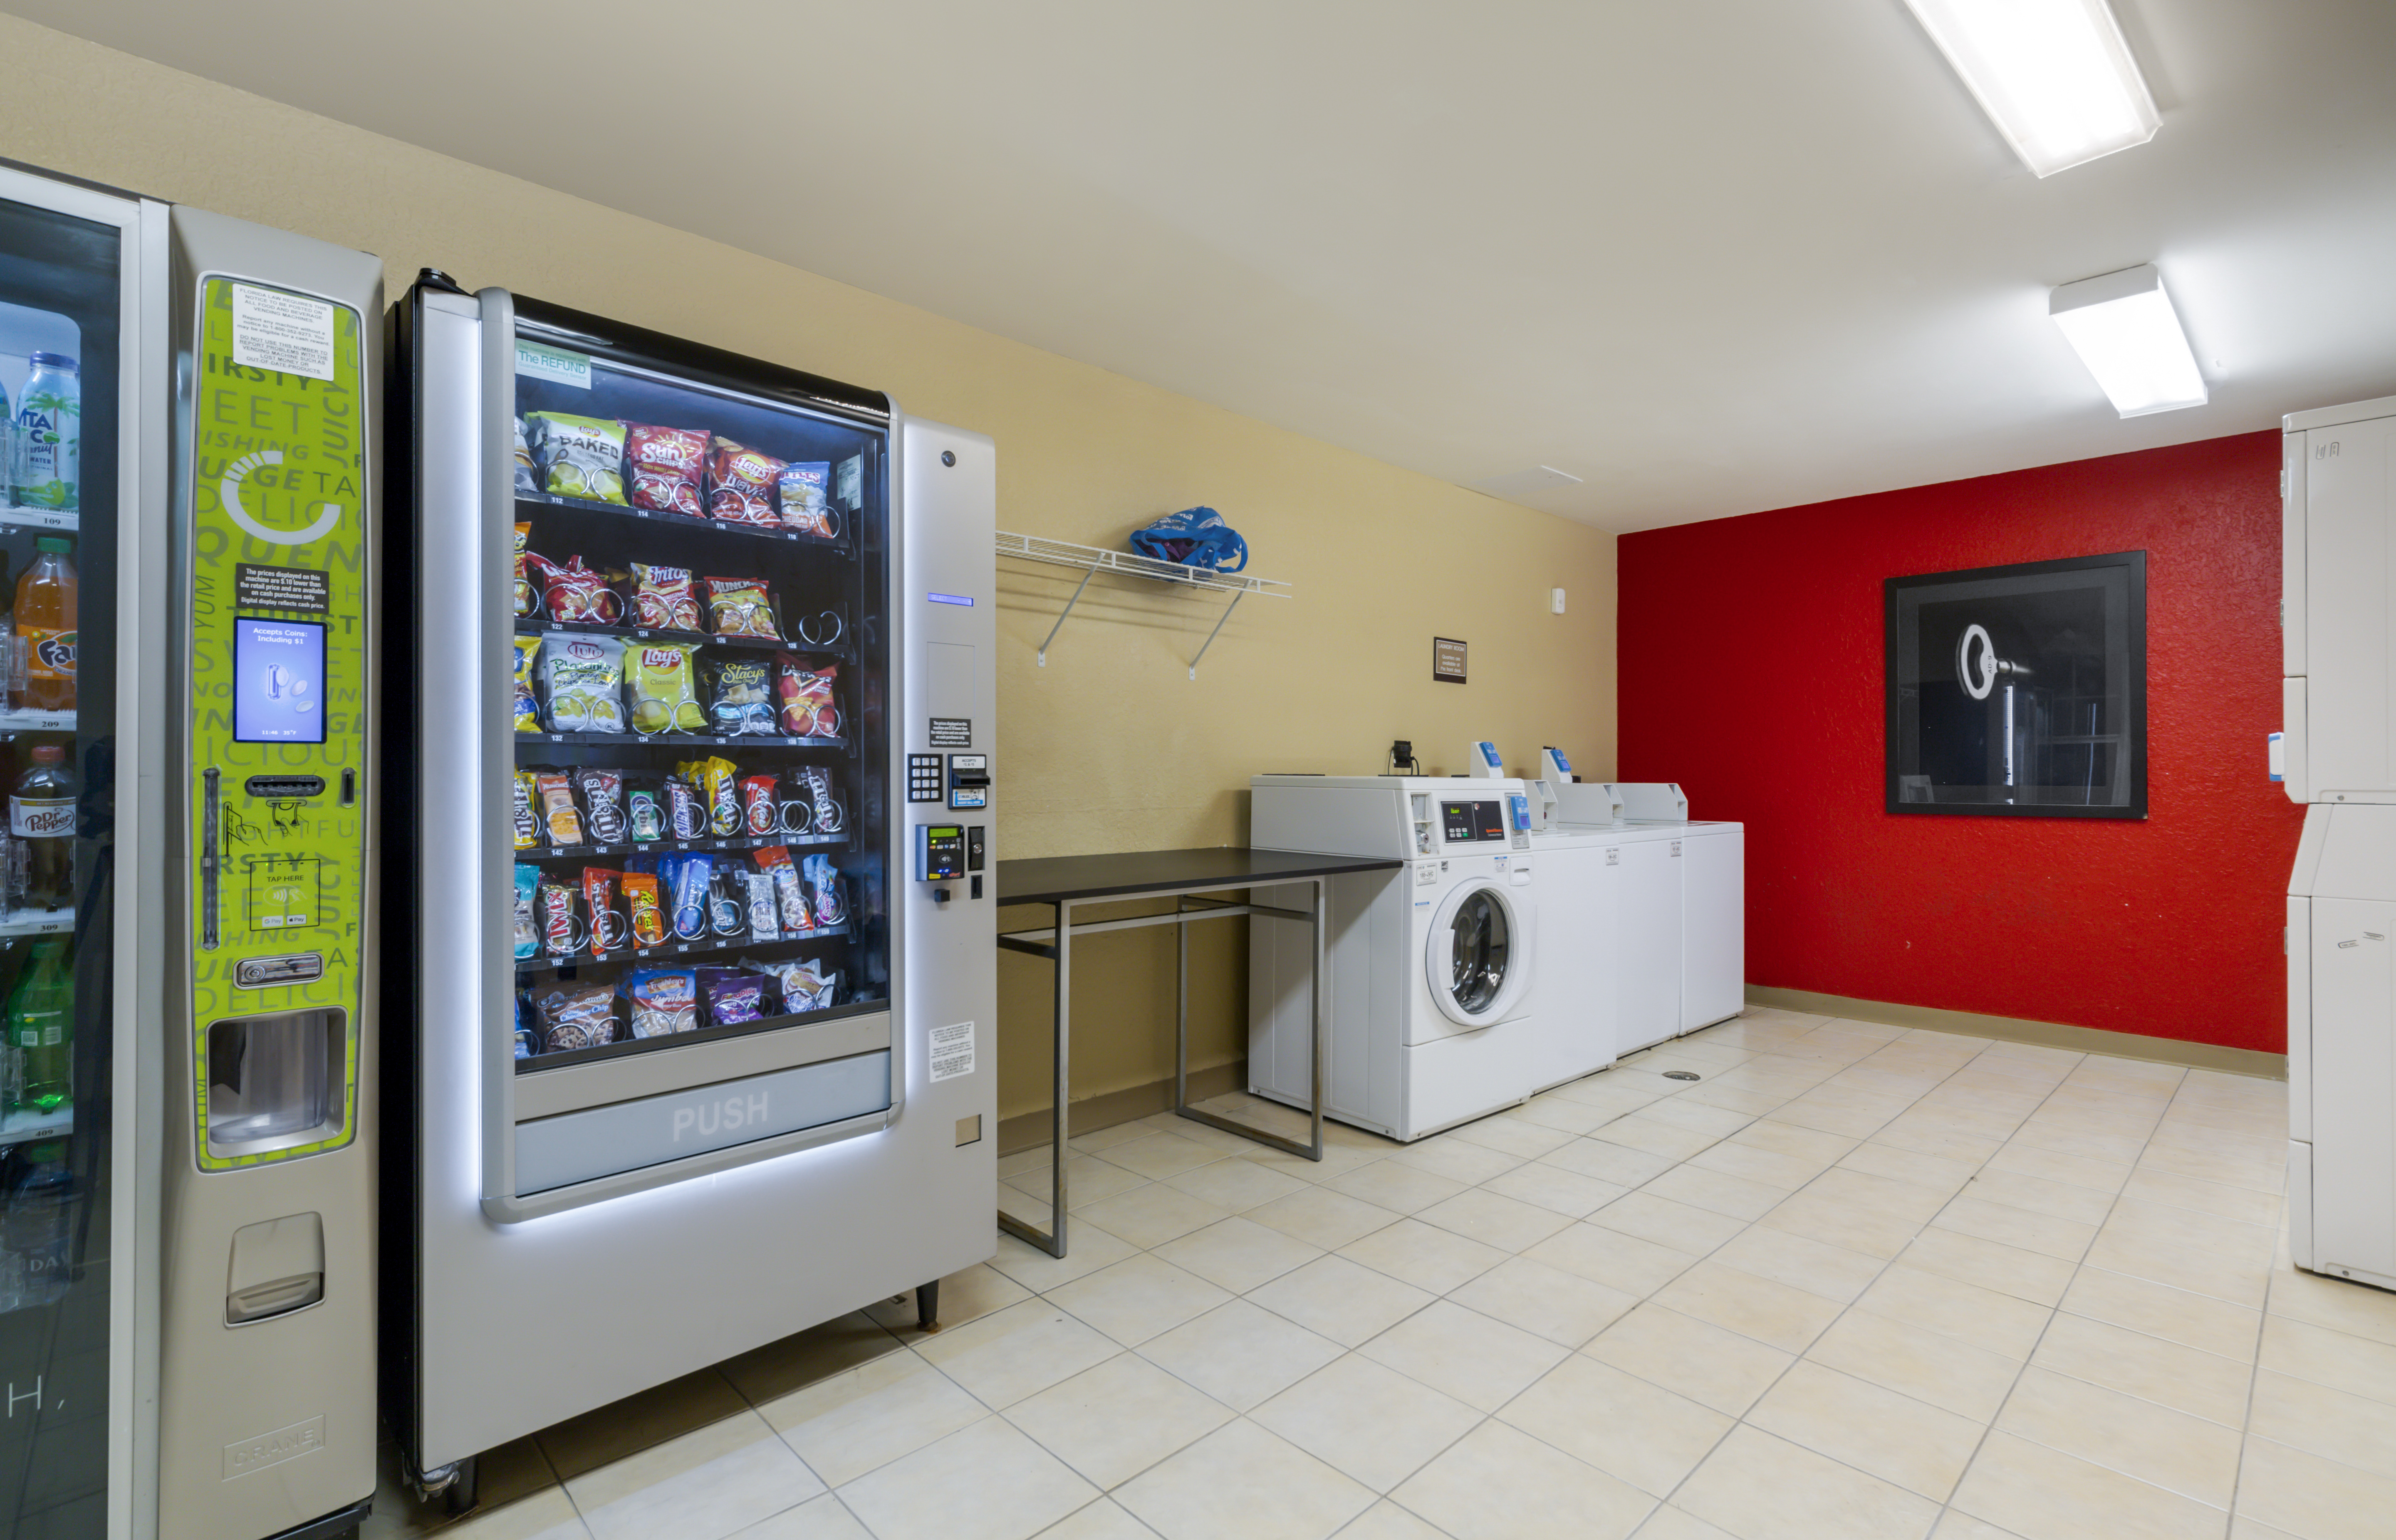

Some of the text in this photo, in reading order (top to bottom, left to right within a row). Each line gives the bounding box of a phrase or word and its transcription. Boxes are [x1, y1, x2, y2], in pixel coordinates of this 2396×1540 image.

[240, 288, 266, 297] FLORIDA
[283, 298, 312, 307] REQUIRES
[254, 307, 314, 323] VENDING MACHINES.
[289, 304, 312, 313] POSTED
[291, 310, 323, 320] BEVERAGE
[519, 350, 586, 374] The REFUND
[559, 435, 618, 460] BAKED
[641, 442, 686, 462] Sun
[656, 457, 683, 469] CHIPS
[737, 457, 767, 478] Lay's
[650, 566, 689, 585] Fritos
[258, 635, 292, 644] Including
[645, 649, 681, 667] Lay's
[721, 664, 765, 684] Stacy's
[25, 814, 71, 831] Pepper
[42, 812, 60, 822] Dr
[549, 892, 570, 941] TWIX
[649, 978, 684, 989] Freshley's
[560, 1004, 609, 1021] Chocolate Chip
[673, 1091, 768, 1142] PUSH
[235, 1429, 314, 1466] CRANE
